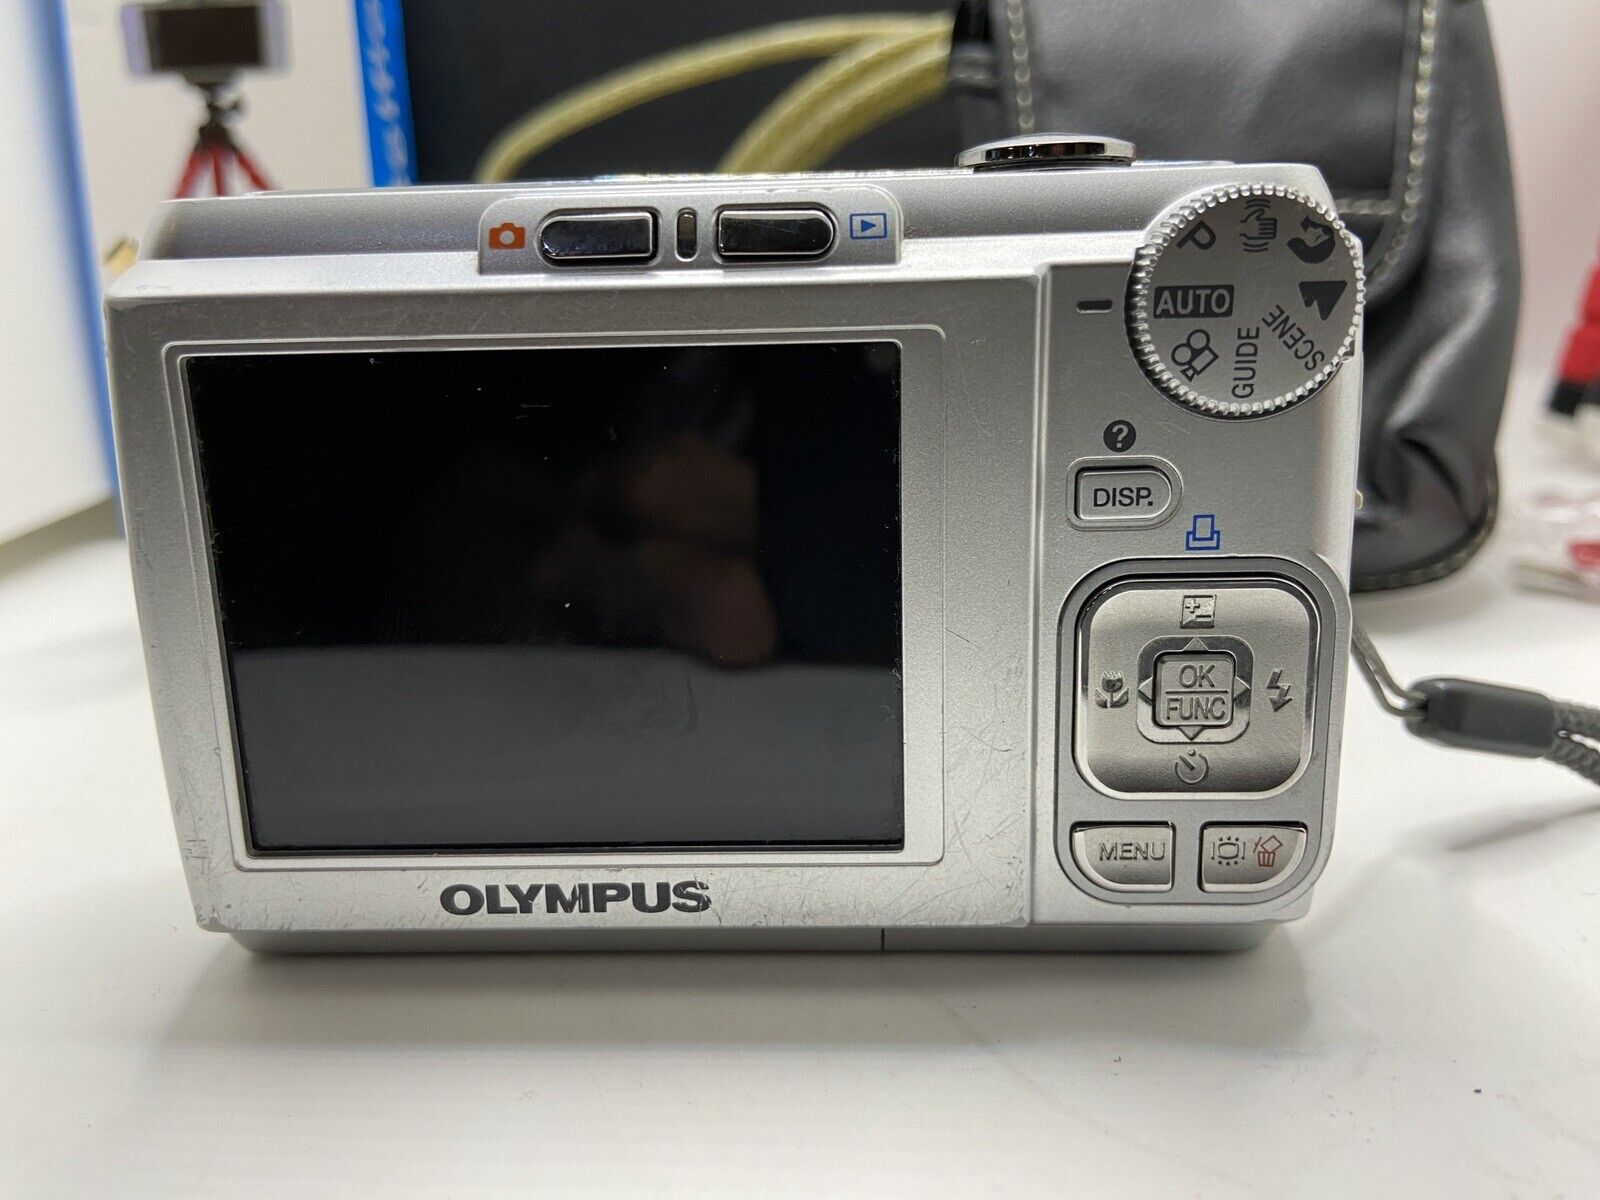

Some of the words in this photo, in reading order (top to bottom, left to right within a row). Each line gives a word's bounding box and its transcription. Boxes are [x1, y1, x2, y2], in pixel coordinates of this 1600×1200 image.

[1177, 220, 1217, 251] P
[1155, 288, 1231, 316] AUTO
[1262, 304, 1325, 372] SCENE
[1231, 326, 1260, 399] GUIDE
[1093, 486, 1154, 508] DISP.
[1178, 664, 1216, 689] OK
[1165, 696, 1226, 721] FUNC
[1099, 841, 1166, 861] MENU
[439, 880, 712, 916] OLYMPUS
